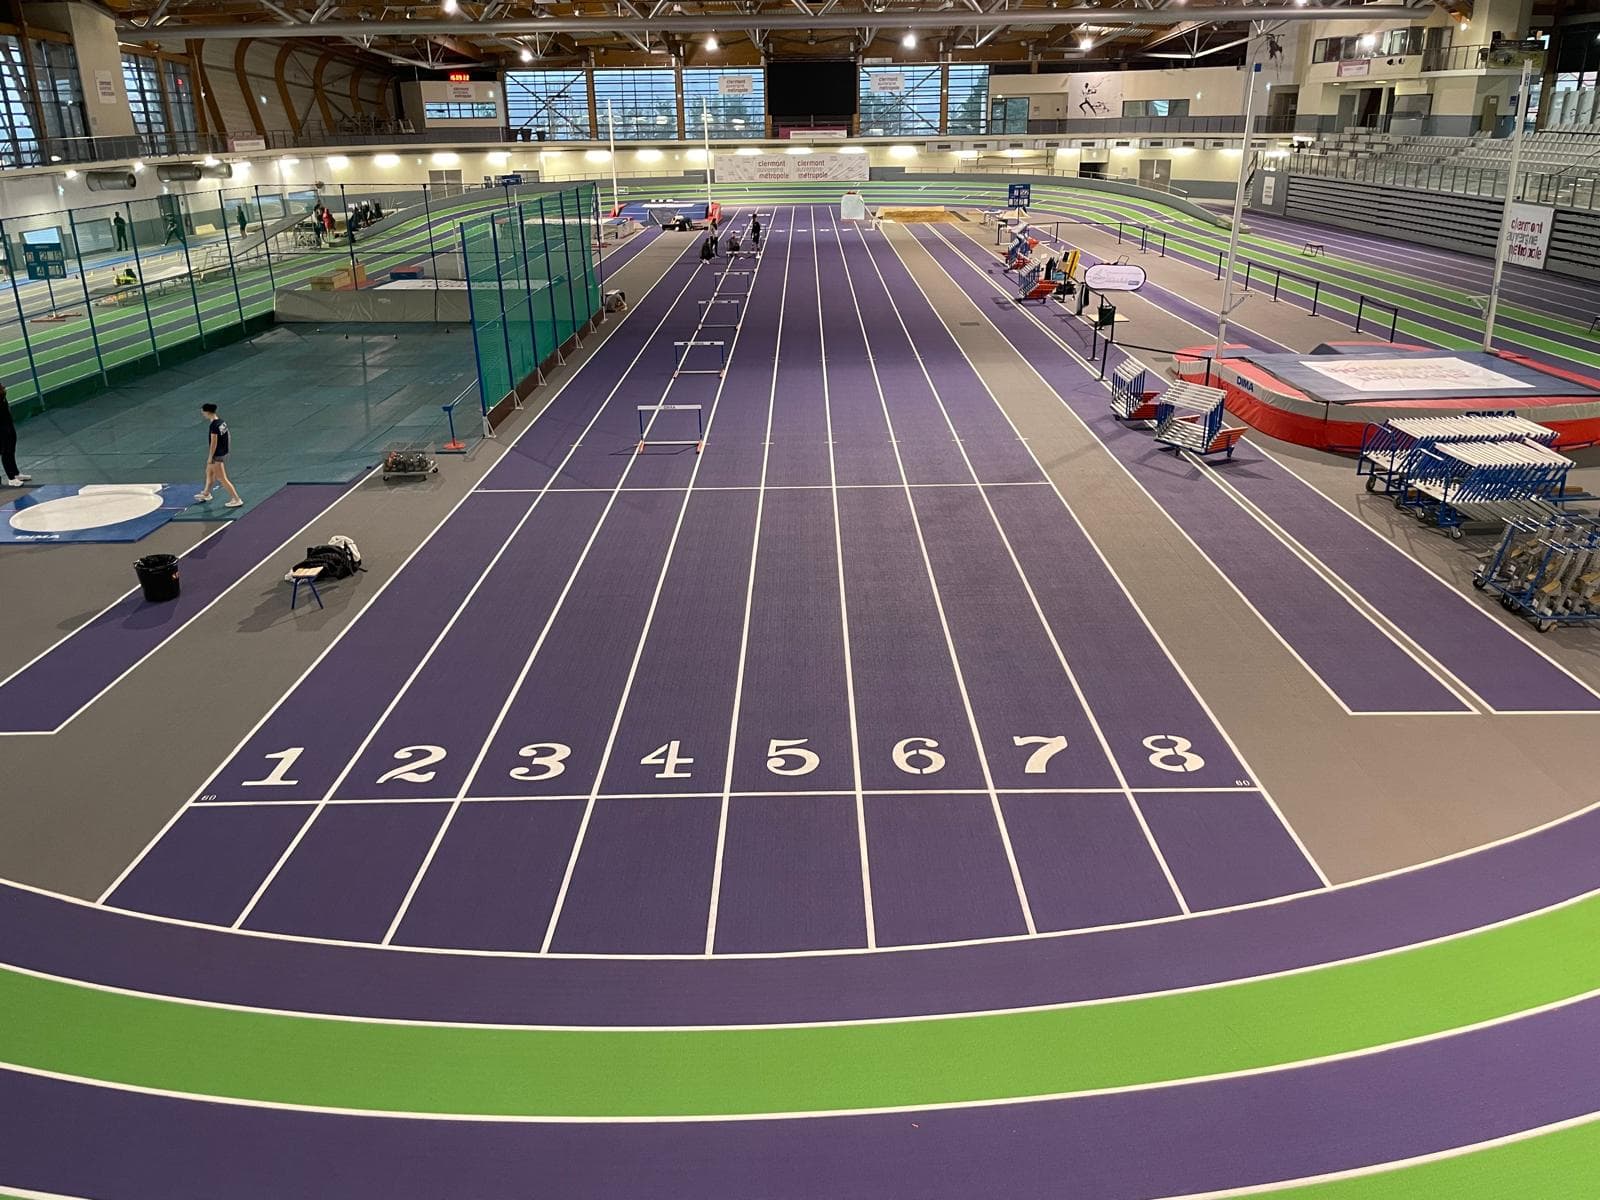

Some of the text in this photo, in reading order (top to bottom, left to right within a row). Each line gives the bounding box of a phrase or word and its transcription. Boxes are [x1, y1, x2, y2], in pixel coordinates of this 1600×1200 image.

[241, 747, 305, 786] 1
[376, 744, 447, 784] 2
[509, 742, 572, 781] 3
[640, 740, 694, 779] 4
[766, 738, 820, 776] 5
[892, 737, 946, 775] 6
[1012, 735, 1068, 774] 7
[1142, 734, 1206, 774] 8
